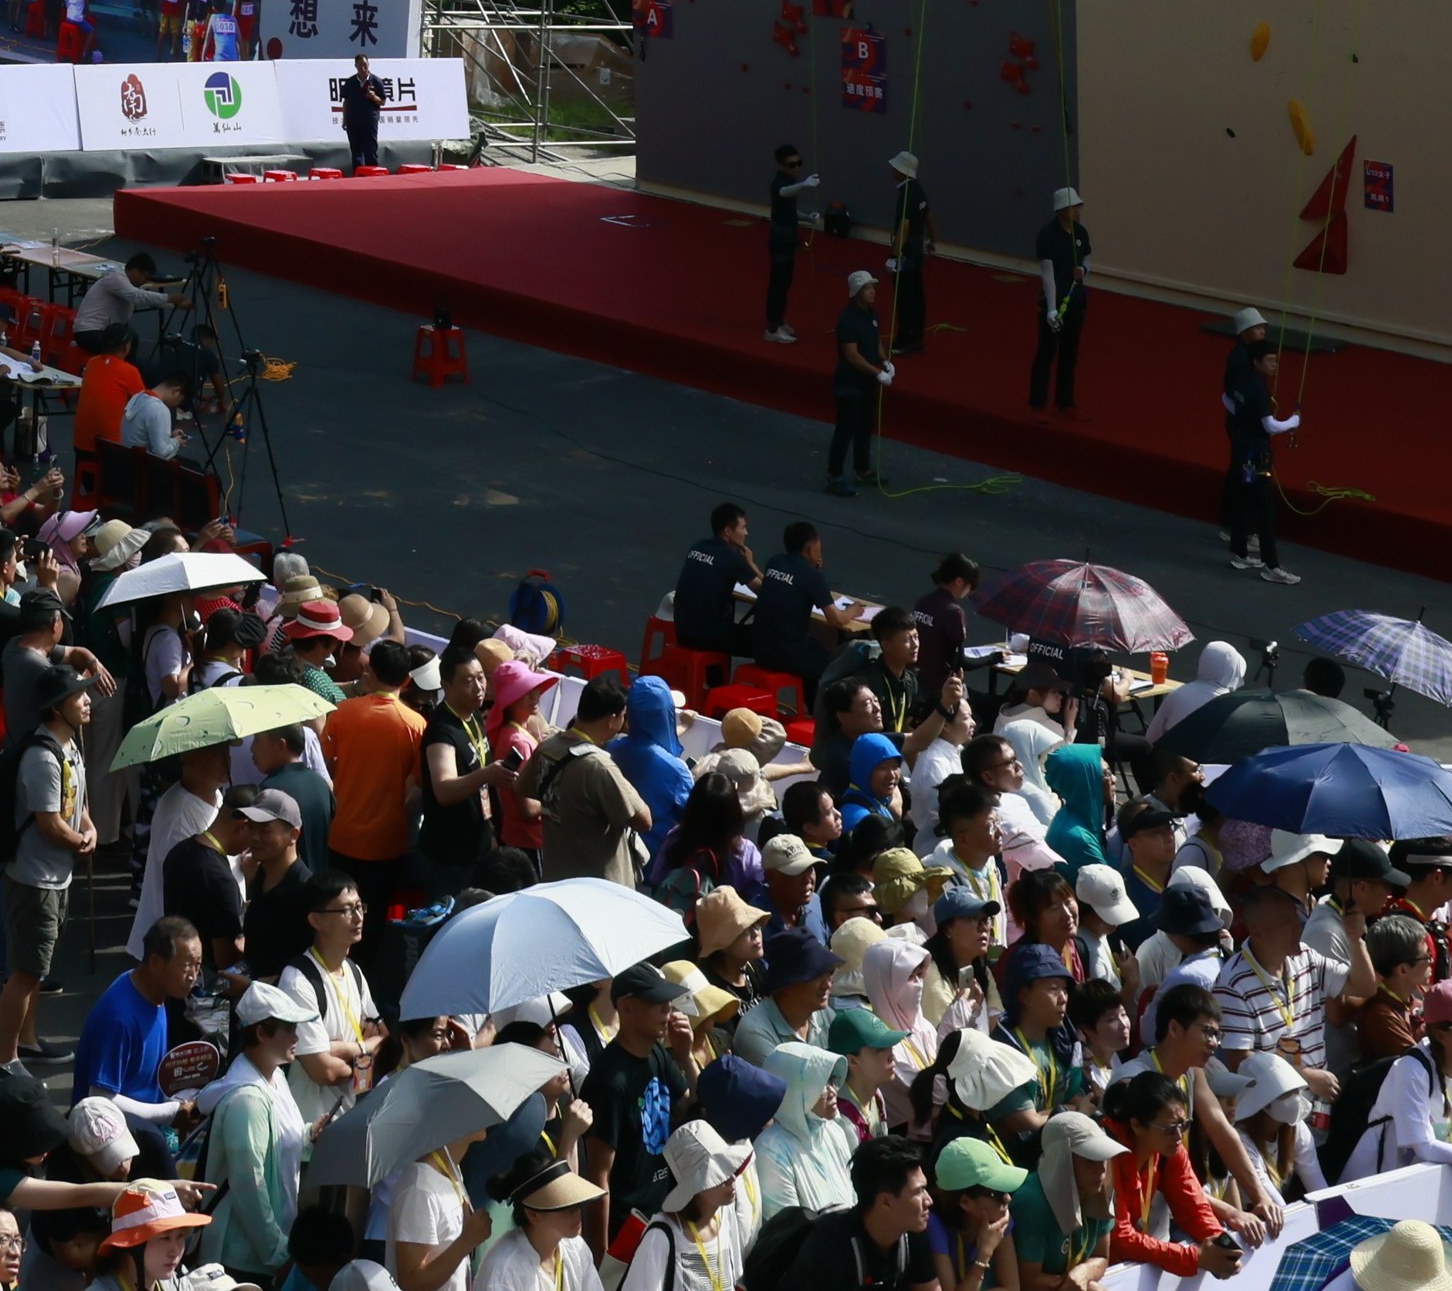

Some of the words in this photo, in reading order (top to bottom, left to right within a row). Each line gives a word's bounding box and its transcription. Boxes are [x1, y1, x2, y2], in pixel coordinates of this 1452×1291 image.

[647, 9, 658, 26] A
[858, 42, 869, 59] B
[846, 83, 883, 99] 速度预赛
[1366, 168, 1391, 180] U13女子
[688, 549, 715, 567] OFFICIAL
[1030, 642, 1064, 661] OFFICIAL
